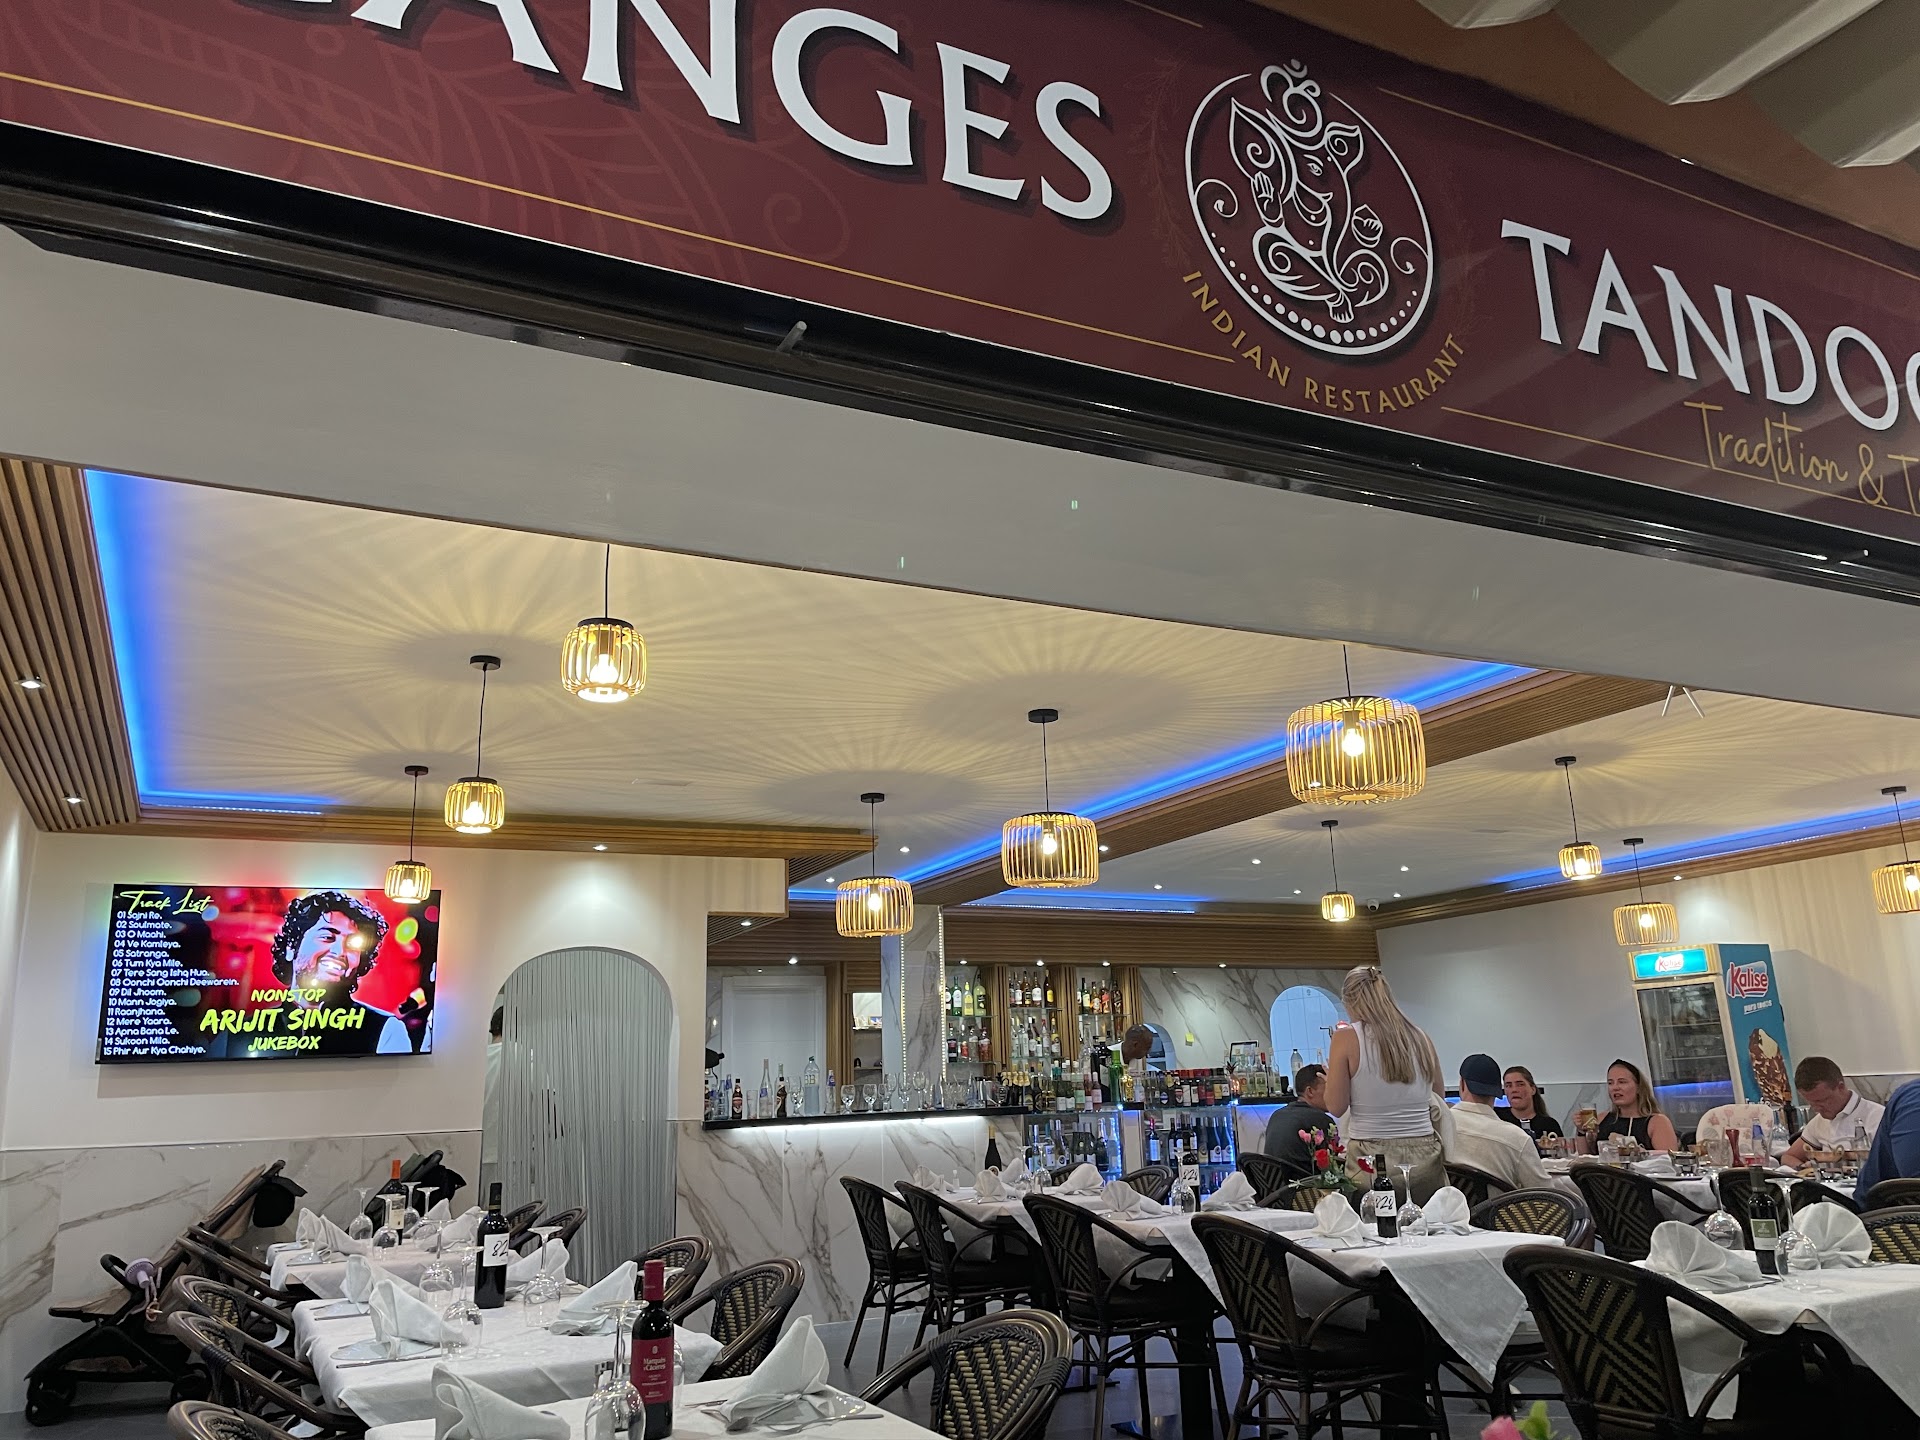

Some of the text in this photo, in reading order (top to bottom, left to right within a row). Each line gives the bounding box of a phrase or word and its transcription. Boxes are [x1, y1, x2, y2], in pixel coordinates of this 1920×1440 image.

[1501, 219, 1920, 431] TANDO
[1183, 270, 1465, 413] INDIAN RESTAURANT
[1684, 401, 1848, 483] Tradition
[1858, 443, 1888, 505] &
[120, 888, 214, 915] Track List
[127, 912, 147, 920] Sajni
[114, 940, 181, 949] 04 Ve Kamleya.
[126, 950, 169, 959] Satranga.
[146, 960, 161, 968] Kya
[146, 969, 168, 978] Sang
[170, 969, 189, 978] Ishq
[190, 978, 239, 986] Deewarein.
[1730, 963, 1768, 997] Kalise
[109, 988, 166, 996] 09 Dil Jhoom.
[251, 988, 326, 1003] NONSTOP
[109, 998, 117, 1006] 10
[118, 998, 144, 1006] Mann
[143, 1017, 172, 1025] Yaara.
[200, 1007, 366, 1034] ARIJIT SINGH
[115, 1028, 139, 1037] Apna
[140, 1027, 164, 1035] Bana
[248, 1035, 322, 1051] JUKEBOX
[113, 1047, 131, 1055] Phir
[151, 1047, 167, 1055] Kya
[169, 1046, 206, 1054] Chahiye.
